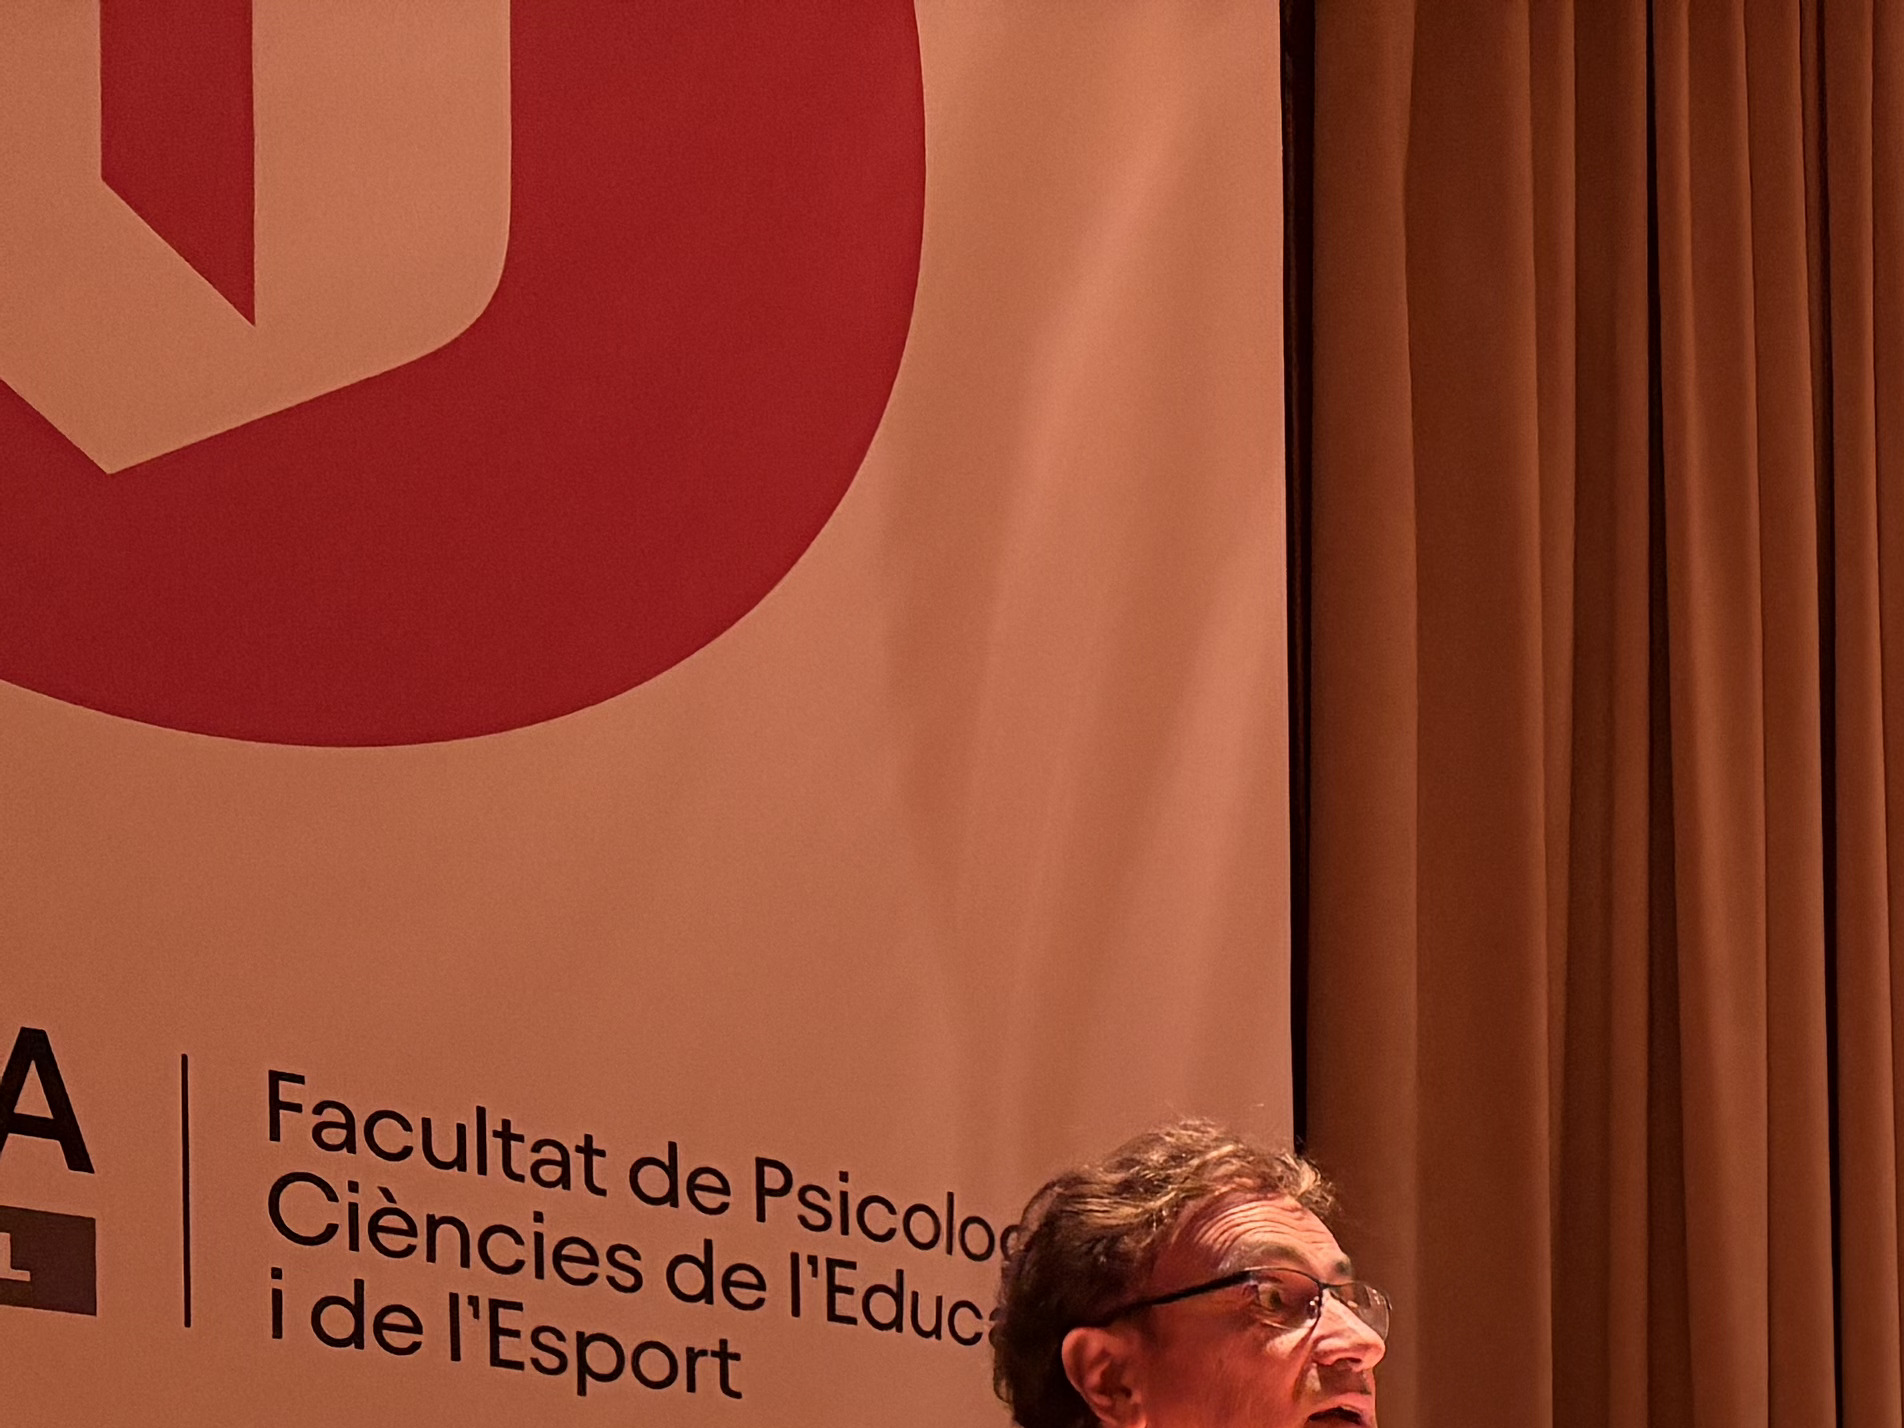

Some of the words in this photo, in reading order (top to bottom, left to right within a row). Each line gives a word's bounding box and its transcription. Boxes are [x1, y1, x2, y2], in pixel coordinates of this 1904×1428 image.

[266, 1068, 608, 1199] Facultat
[628, 1141, 733, 1217] de
[266, 1170, 644, 1295] Ciències
[665, 1240, 767, 1314] de
[788, 1250, 1004, 1347] l'Educ
[270, 1267, 284, 1340] i
[309, 1278, 424, 1357] de
[448, 1291, 742, 1399] l'Esport
